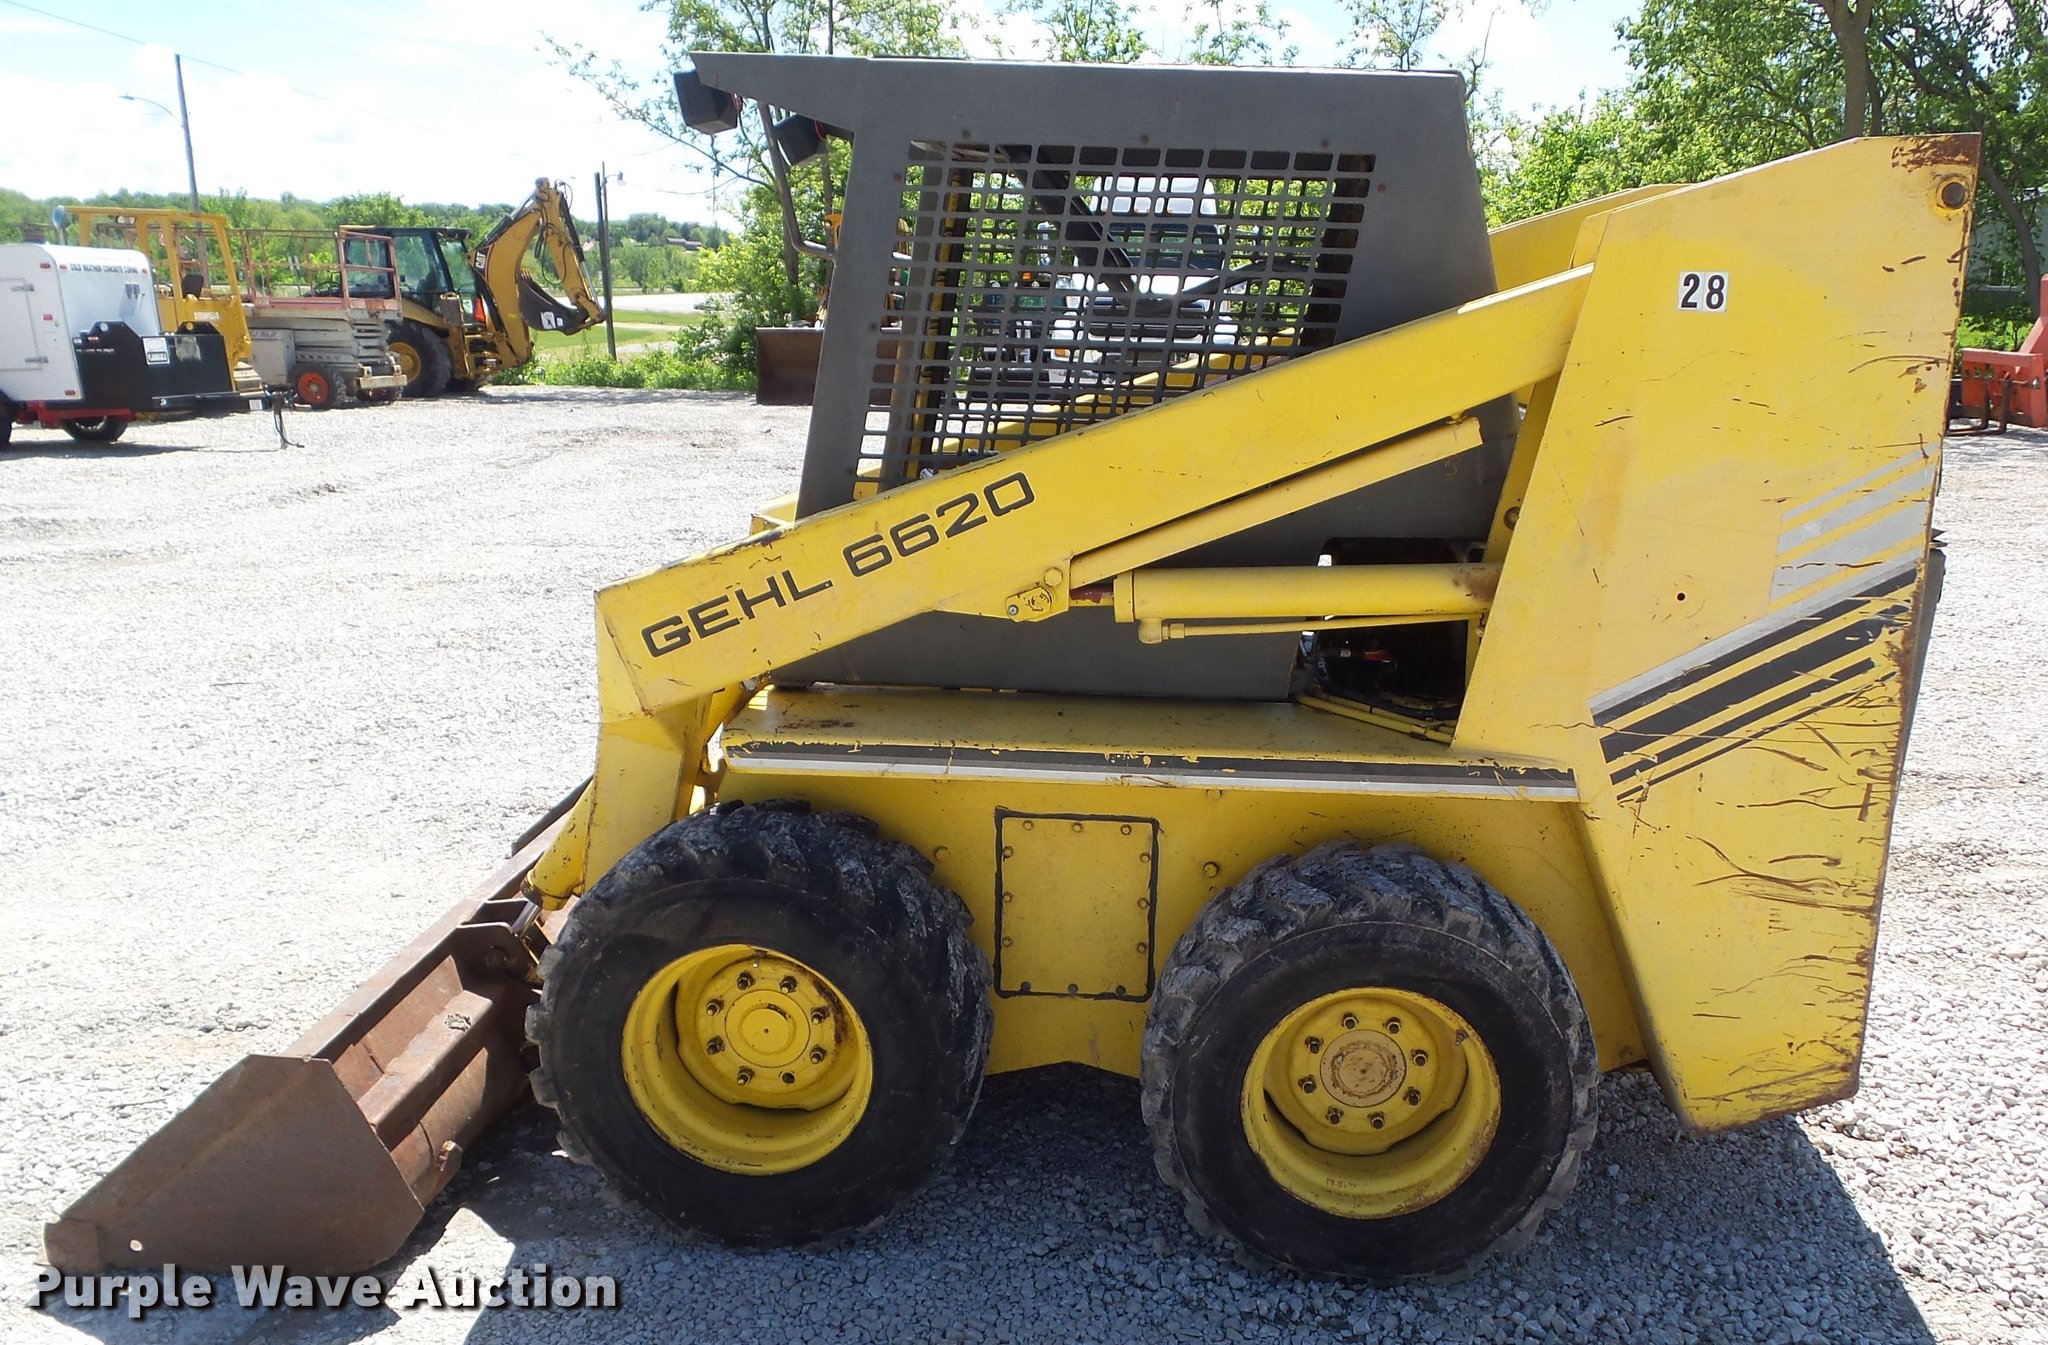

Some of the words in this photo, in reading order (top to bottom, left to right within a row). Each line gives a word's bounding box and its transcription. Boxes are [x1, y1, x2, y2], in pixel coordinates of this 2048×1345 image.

[475, 251, 486, 269] CAT
[1681, 273, 1725, 310] 28
[640, 569, 834, 658] GEHL
[842, 471, 1036, 577] 6620
